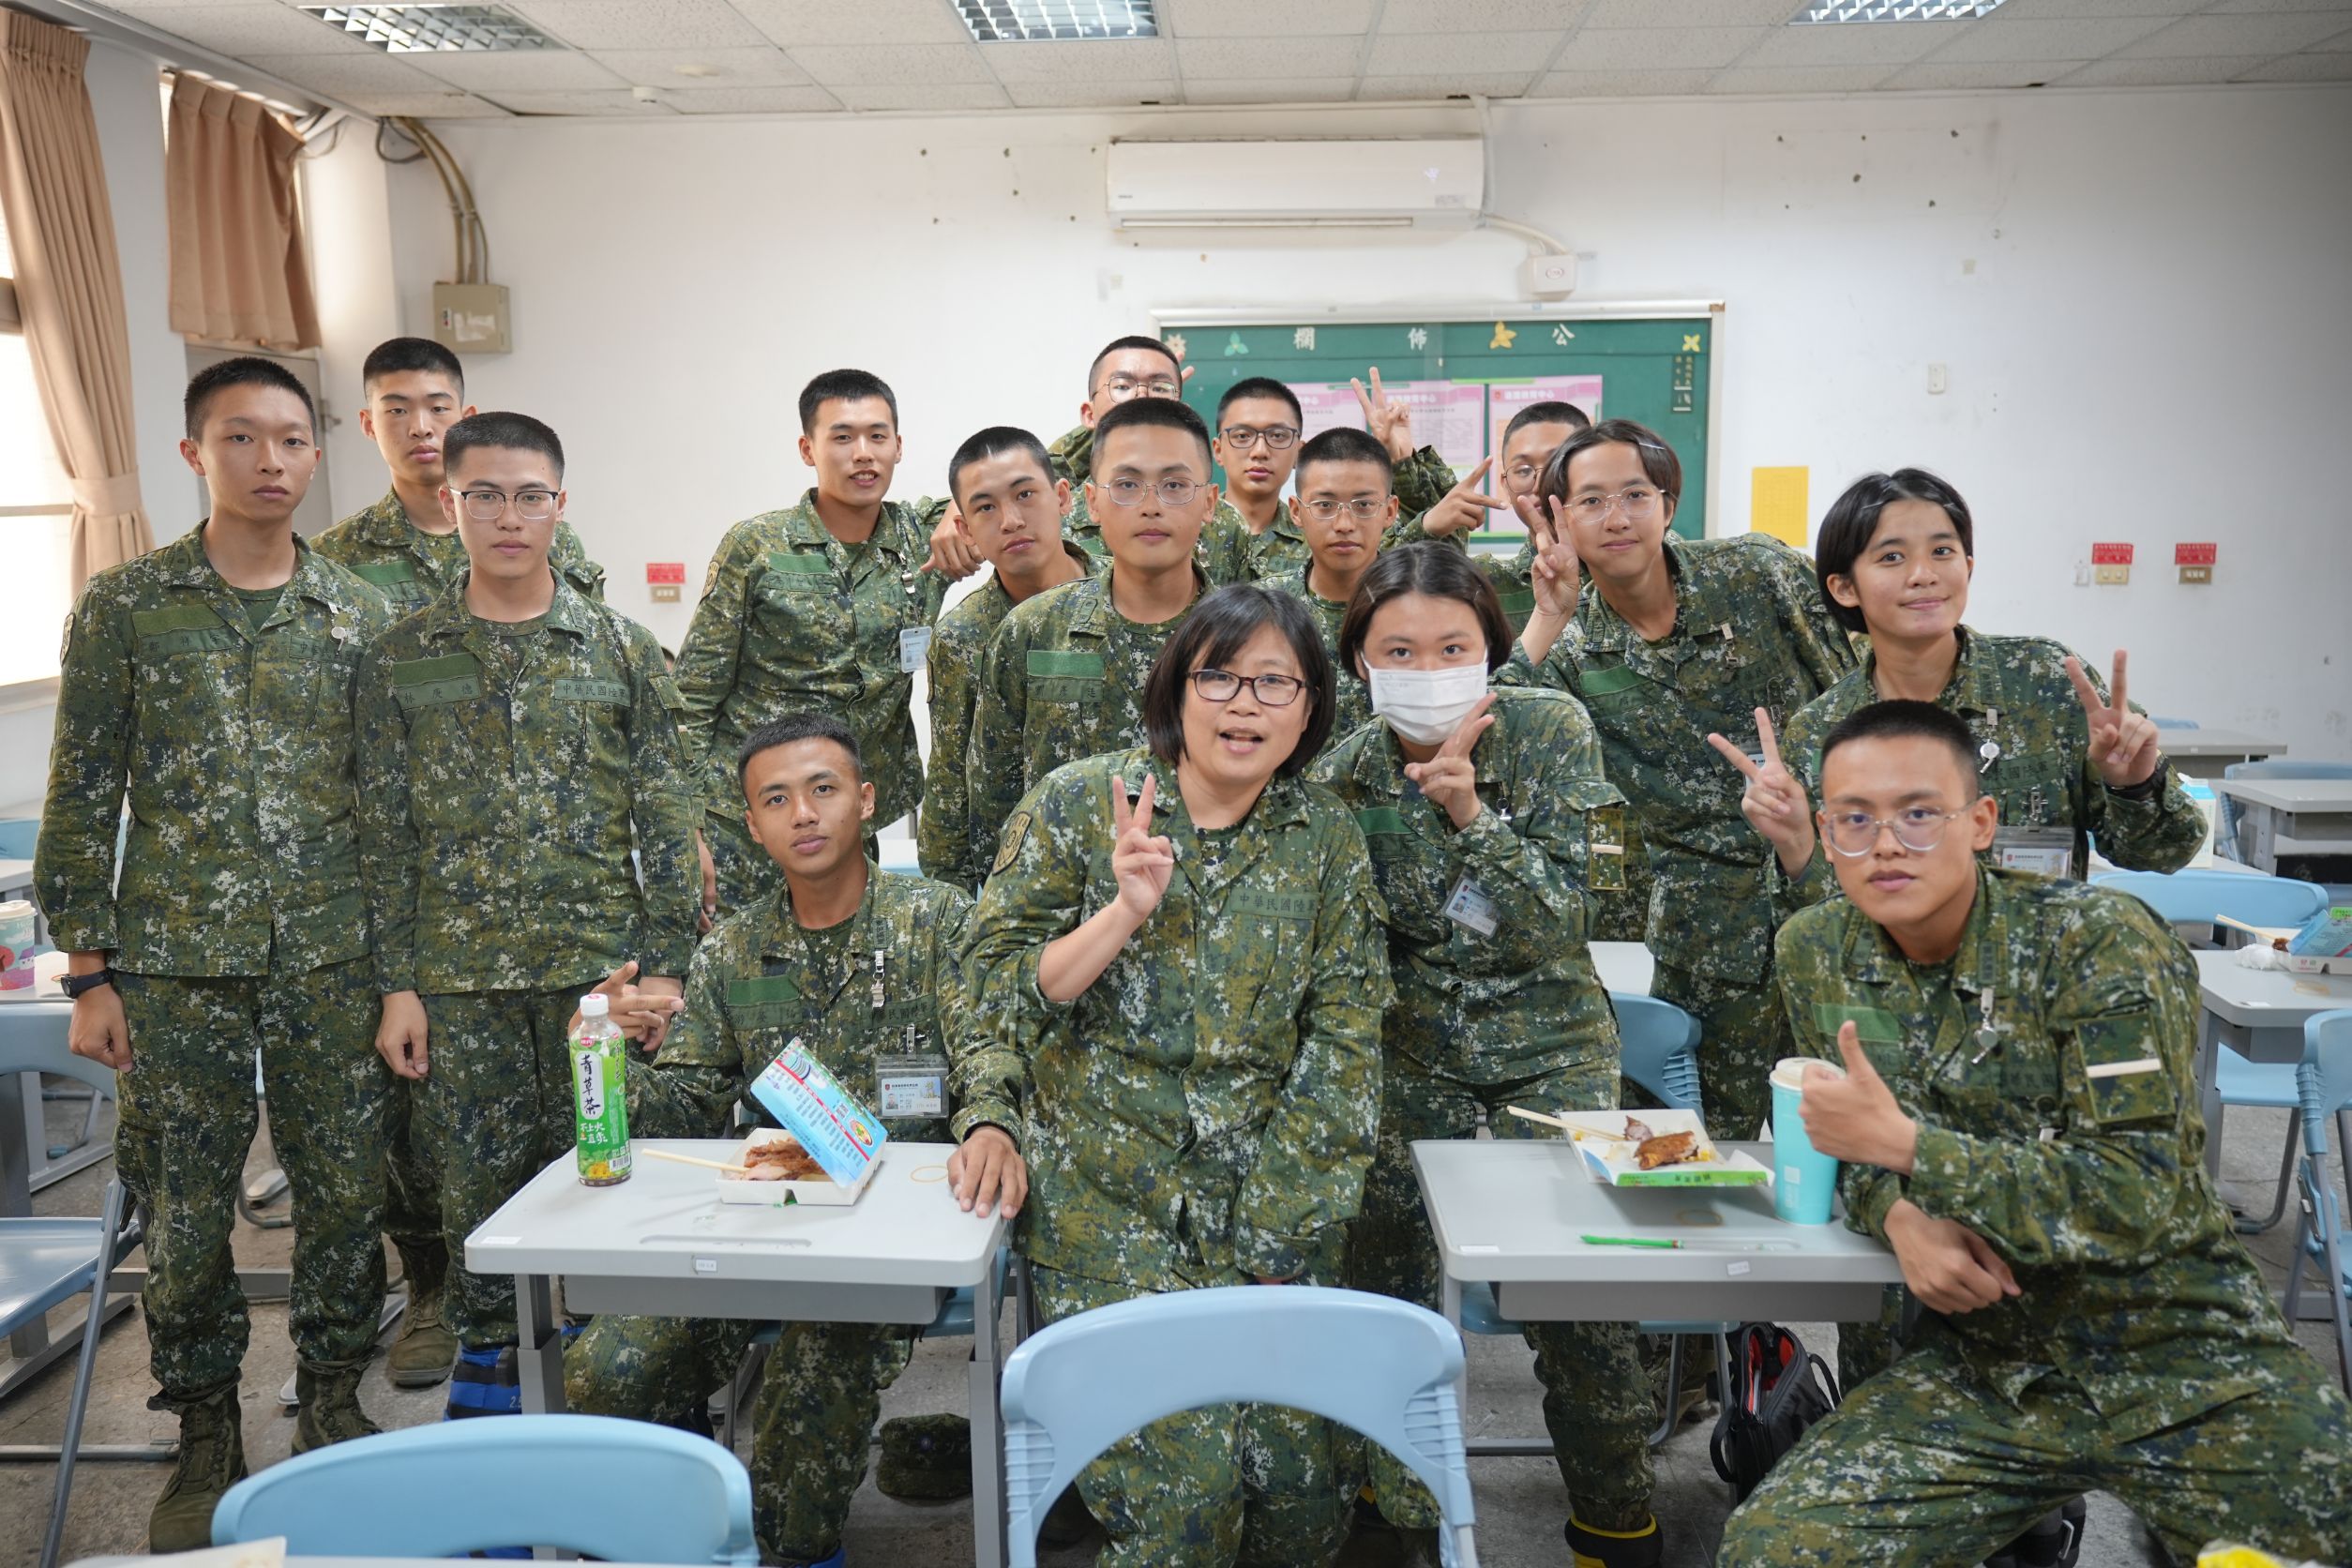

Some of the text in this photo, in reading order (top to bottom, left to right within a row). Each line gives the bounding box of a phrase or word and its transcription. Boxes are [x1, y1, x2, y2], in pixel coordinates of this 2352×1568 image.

[1292, 323, 1576, 352] 公 佈 欄
[563, 683, 626, 701] 中華民國陸軍
[1239, 892, 1317, 913] 中華民國陸軍
[580, 1053, 601, 1116] 青草茶
[580, 1122, 606, 1133] 不上火
